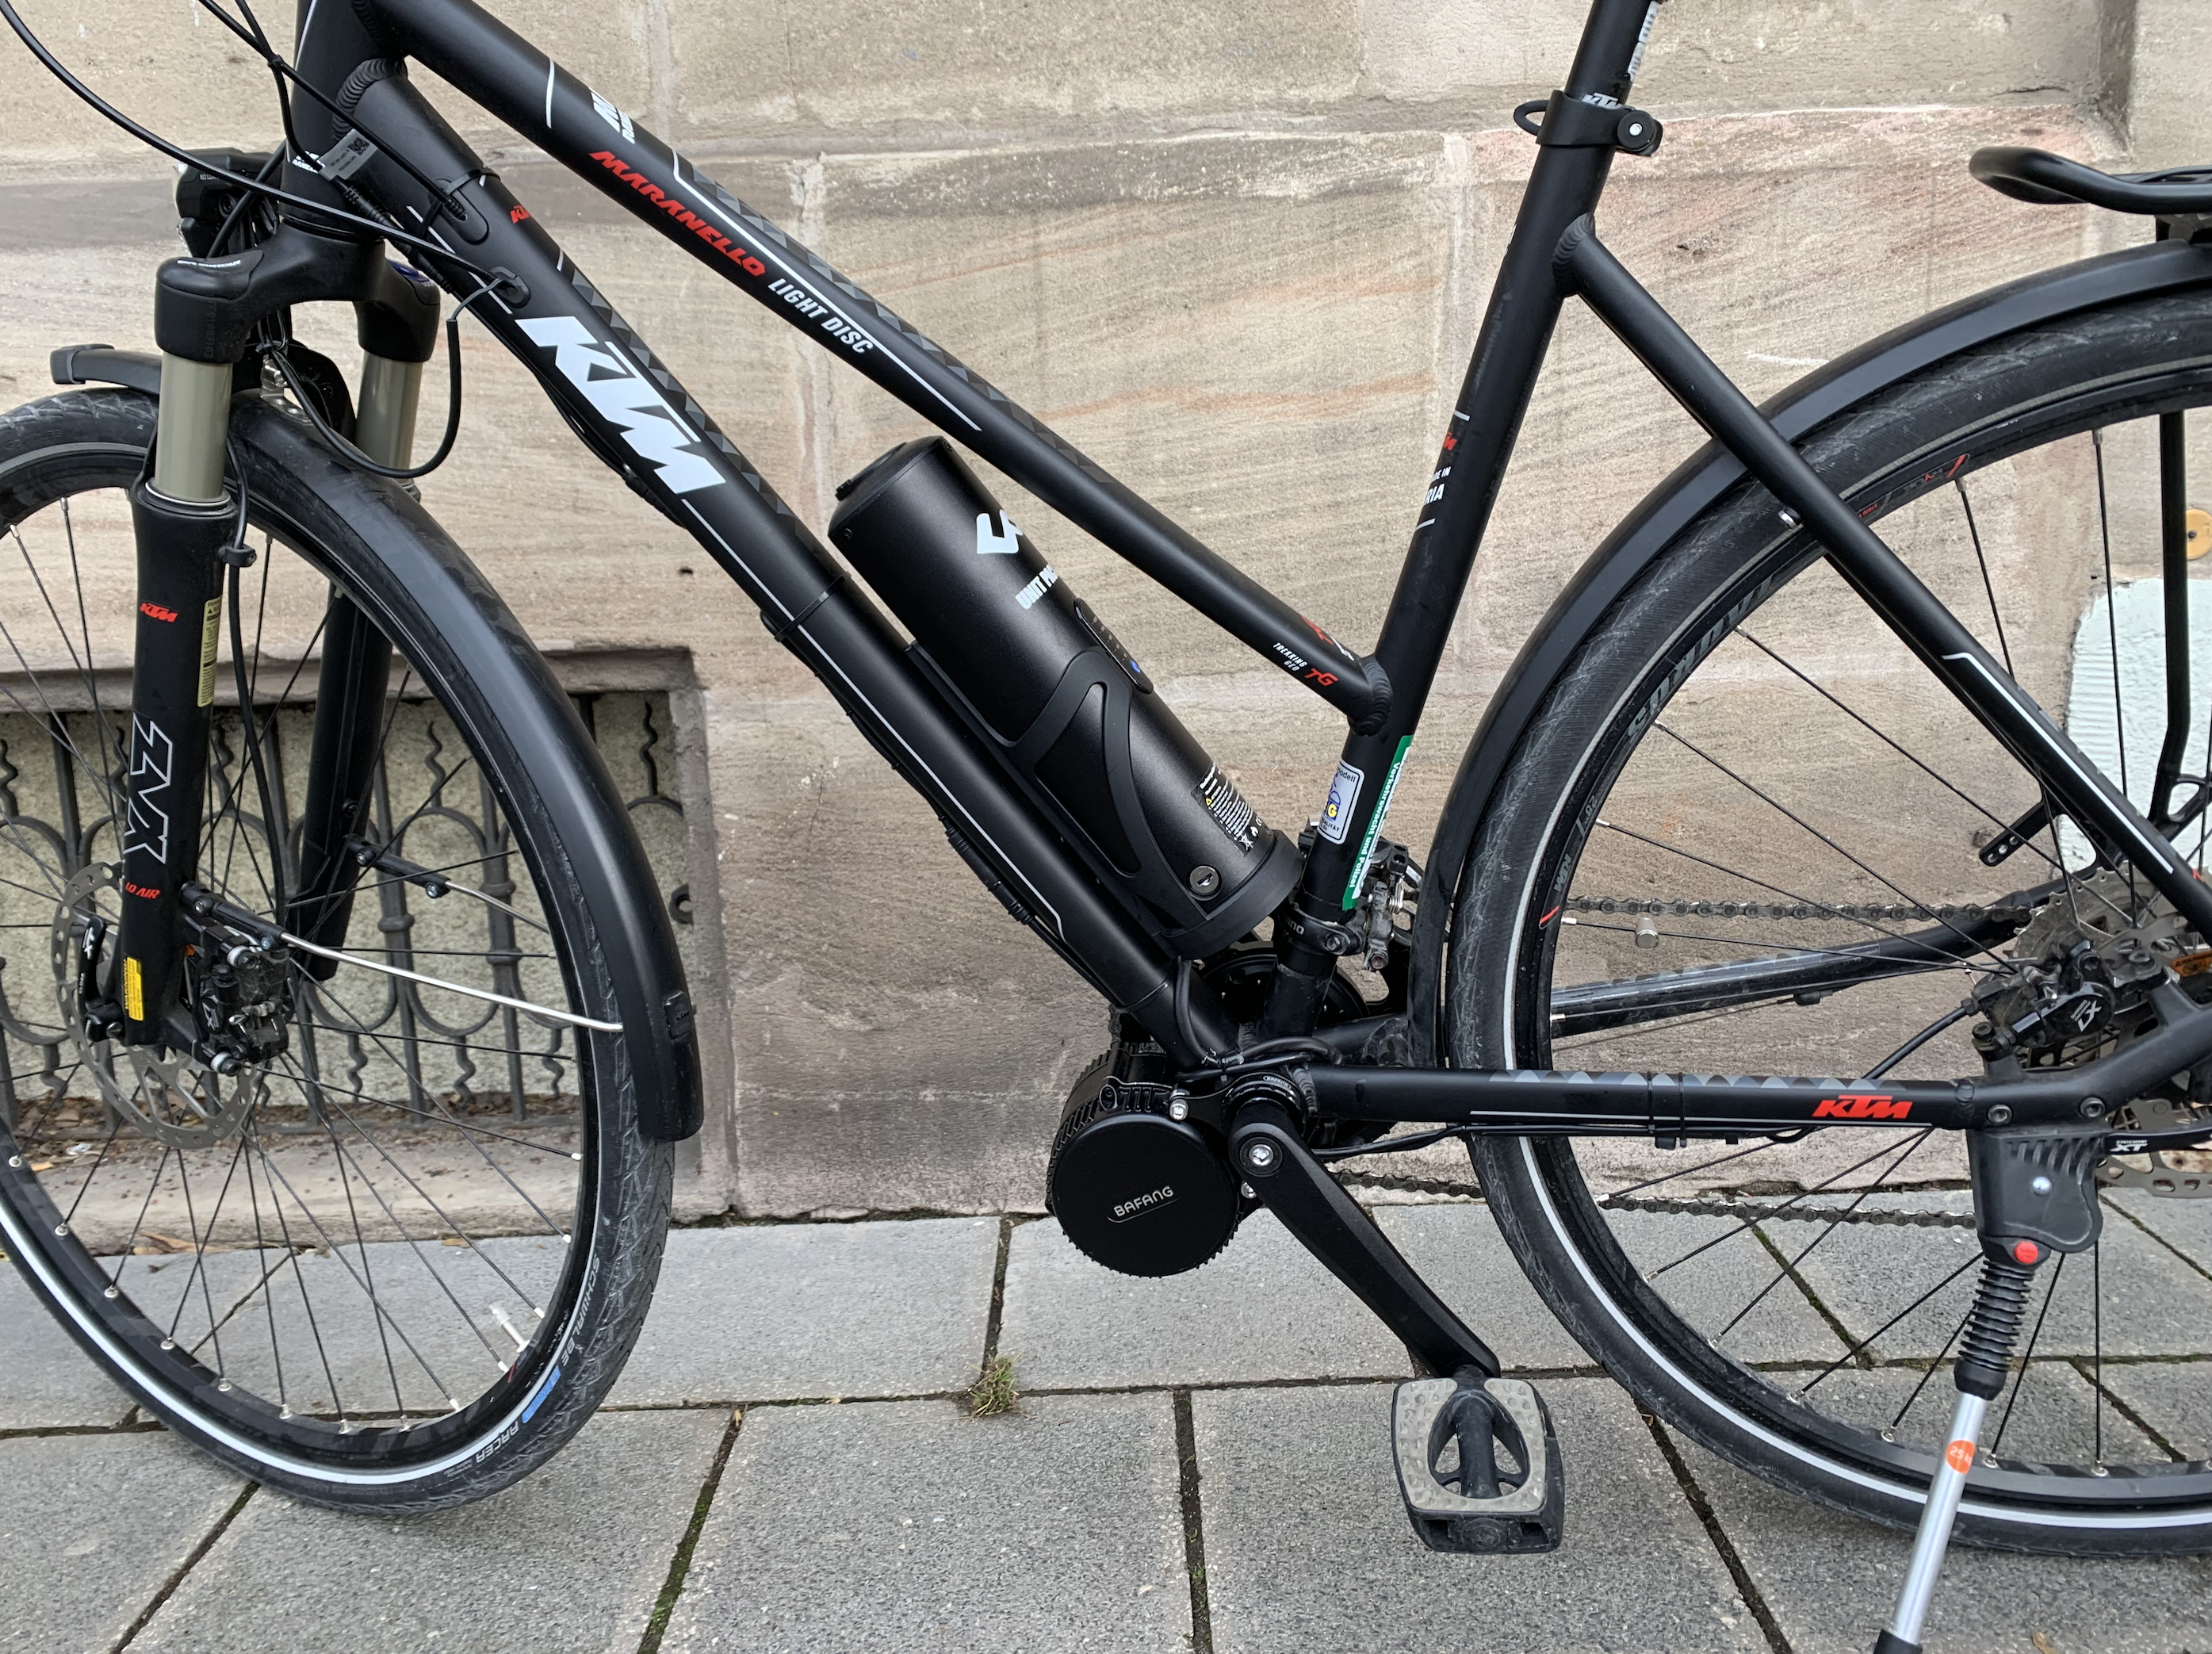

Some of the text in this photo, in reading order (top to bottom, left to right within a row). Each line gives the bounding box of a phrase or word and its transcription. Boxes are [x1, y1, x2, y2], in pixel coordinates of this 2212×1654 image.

[589, 151, 874, 354] MARANELLO LIGHT DISC
[515, 316, 726, 494] KTM
[1015, 576, 1047, 609] UNIT
[140, 602, 178, 623] KTM
[1273, 642, 1307, 668] TREKKING
[1284, 660, 1299, 672] GEO
[1304, 668, 1338, 687] TG
[1366, 761, 1401, 837] Verkehrswacht
[1360, 838, 1372, 856] und
[1349, 856, 1366, 888] Polizei
[1554, 853, 1571, 892] KTM
[136, 886, 161, 899] AIR
[1812, 1094, 1913, 1119] KTM
[1113, 1185, 1174, 1218] BAFANG
[561, 1257, 600, 1367] SCHWALBE
[476, 1420, 519, 1463] RACER
[1949, 1445, 1964, 1459] 25
